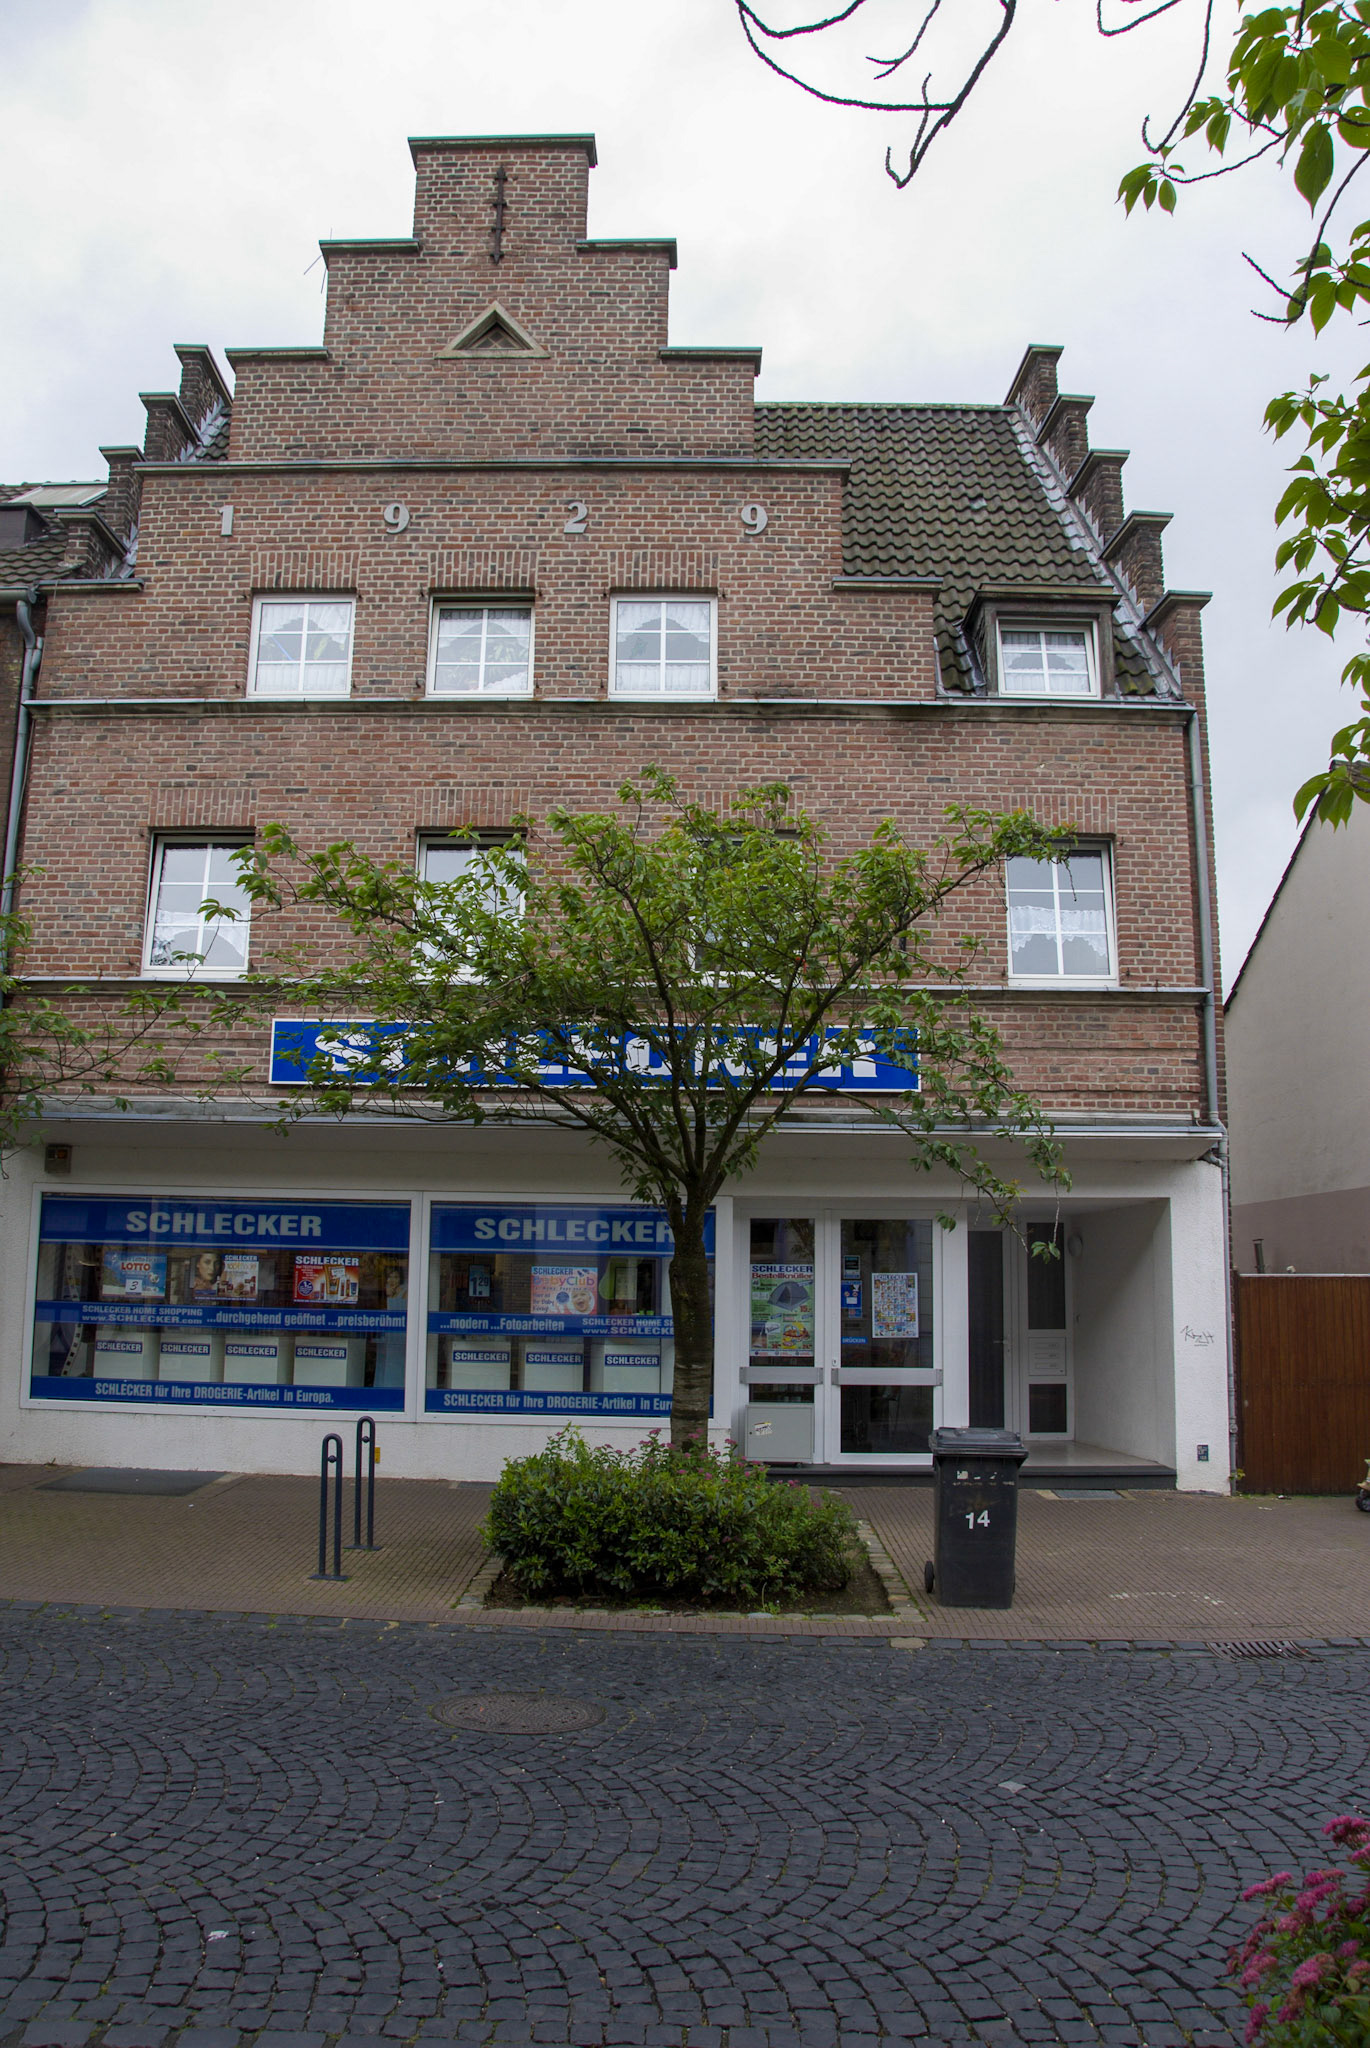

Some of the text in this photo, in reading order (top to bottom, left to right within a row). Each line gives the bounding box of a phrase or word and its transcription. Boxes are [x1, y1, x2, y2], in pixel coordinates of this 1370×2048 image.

[126, 1210, 322, 1237] SCHLECKER
[225, 1254, 258, 1262] SCHLECKER
[295, 1255, 360, 1267] SCHLECKER
[121, 1261, 151, 1271] LOTTO
[533, 1267, 574, 1276] SCHLECKER
[752, 1264, 813, 1273] SCHLECKER
[130, 1280, 140, 1291] 3
[82, 1304, 203, 1317] SCHLECKER HOME SHOPPING
[82, 1313, 203, 1325] www.SCHLECKER.com
[206, 1310, 406, 1328] ...durchgehend geöffnet ...preisberühmt
[439, 1317, 564, 1331] ...modern ...Fotoarbeiten
[582, 1317, 634, 1326] SCHLECKER
[635, 1318, 661, 1327] HOME
[97, 1341, 142, 1352] SCHLECKER
[161, 1343, 209, 1354] SCHLECKER
[227, 1345, 276, 1356] SCHLECKER
[296, 1347, 345, 1358] SCHLECKER
[454, 1351, 508, 1361] SCHLECKER
[527, 1353, 581, 1363] SCHLECKER
[606, 1355, 658, 1365] SCHLECKER
[95, 1382, 334, 1405] SCHLECKER für Ihre DROGERIE-Artikel in Europa.
[443, 1393, 504, 1407] SCHLECKER
[505, 1394, 520, 1408] für
[523, 1395, 544, 1409] Ihre
[546, 1396, 636, 1410] DROGERIE-Artikel
[640, 1397, 651, 1410] in
[965, 1509, 991, 1530] 14
